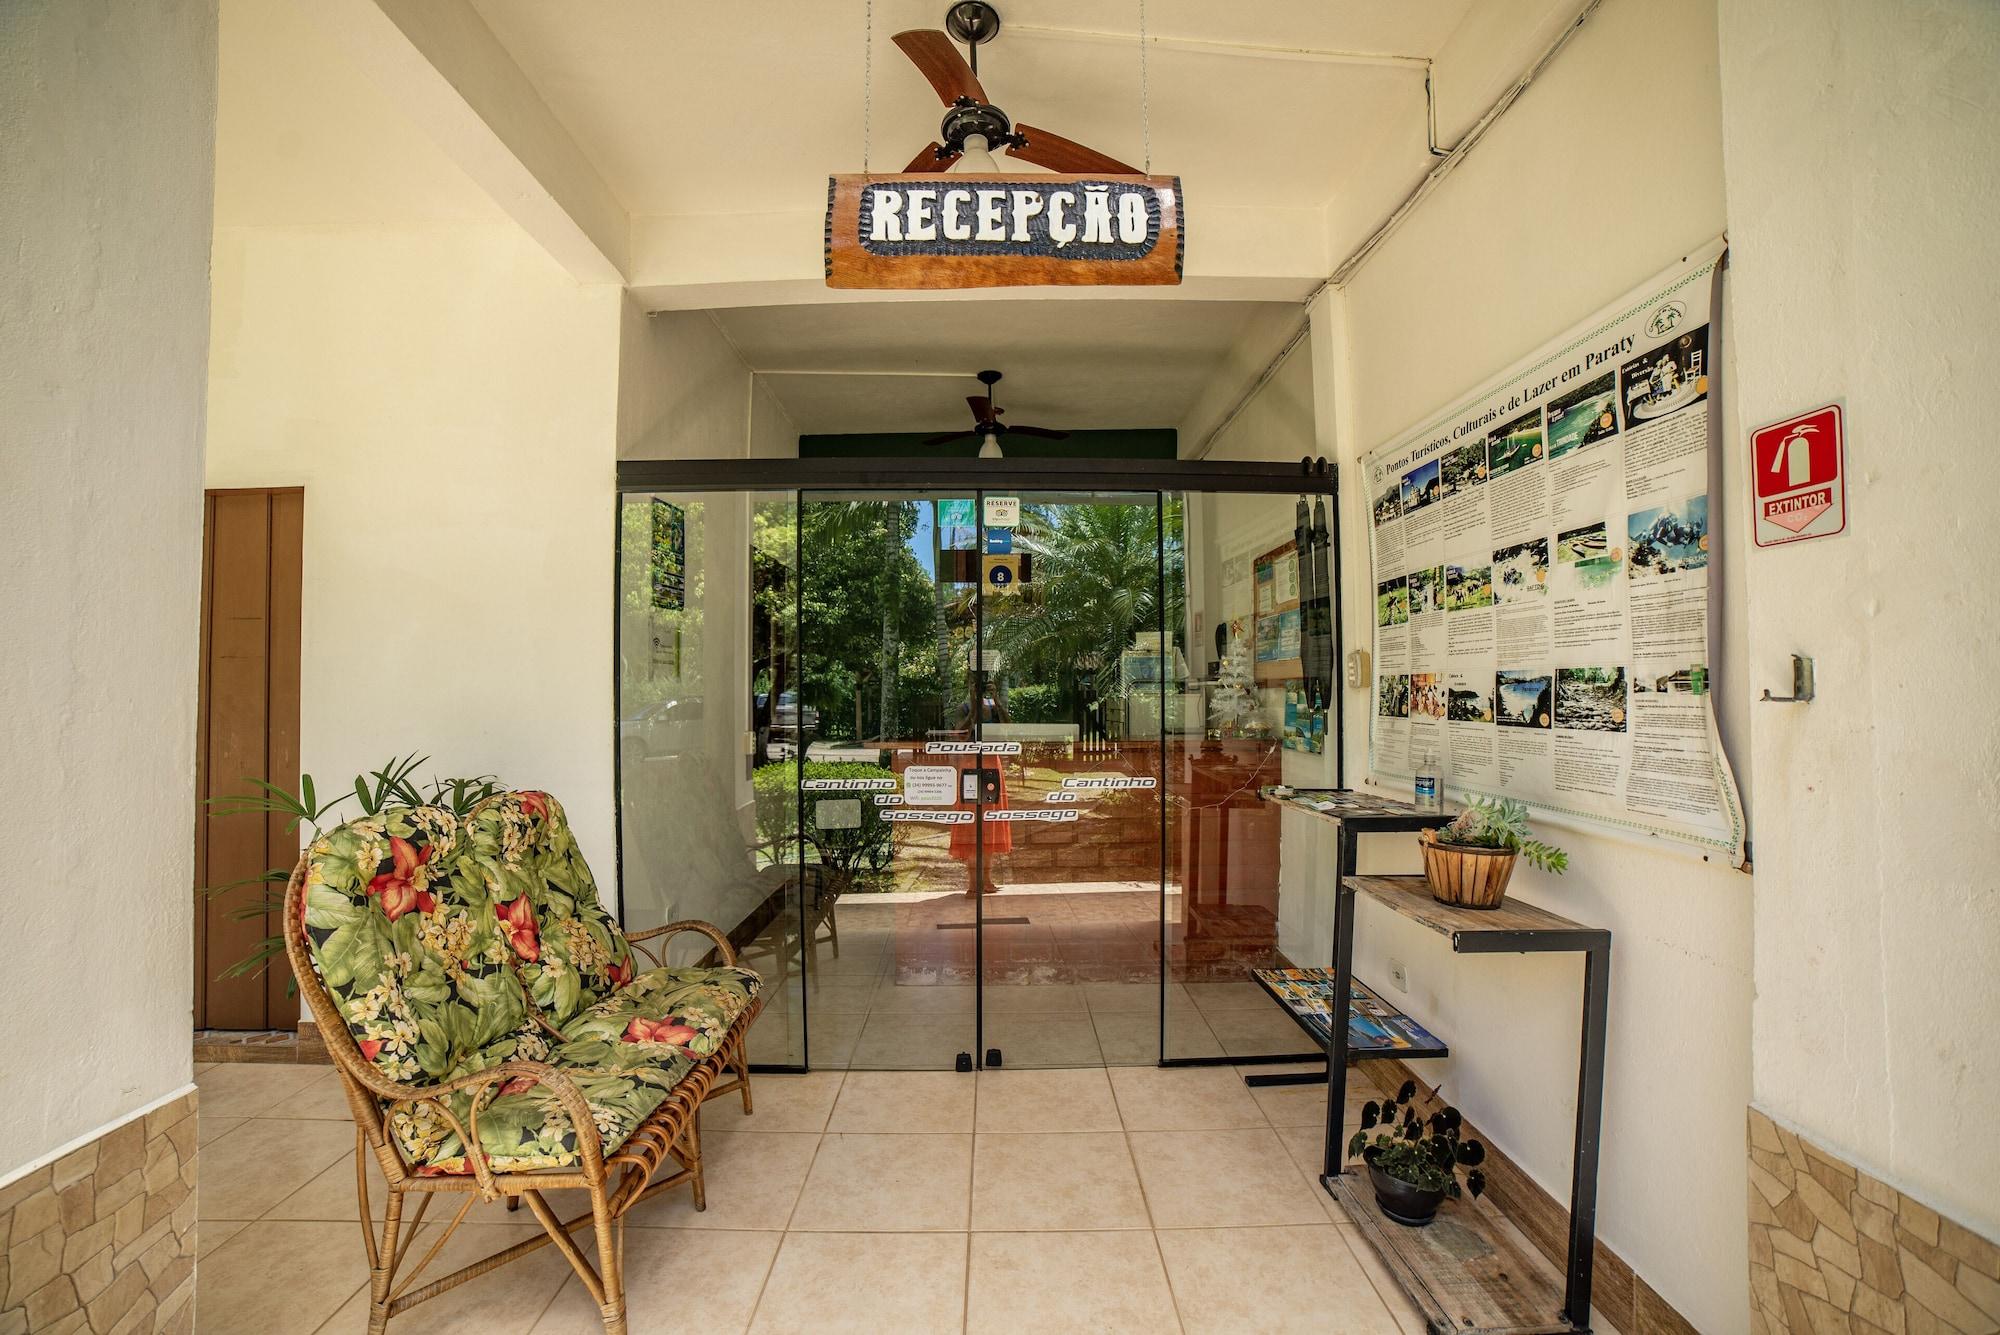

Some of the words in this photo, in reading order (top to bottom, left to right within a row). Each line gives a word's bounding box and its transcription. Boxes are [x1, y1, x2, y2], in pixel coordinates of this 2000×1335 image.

[870, 185, 1149, 249] RECEPÇÃO
[1386, 455, 1409, 475] Pontos
[1411, 435, 1451, 462] Turísticos,
[1453, 408, 1497, 440] Culturais
[1499, 405, 1505, 416] e
[1507, 396, 1520, 412] de
[1523, 376, 1558, 403] Lazer
[1561, 364, 1581, 383] em
[1585, 334, 1635, 371] Paraty
[1768, 491, 1826, 516] EXTINTOR
[997, 572, 1004, 581] 8
[926, 742, 1020, 753] Pousada
[802, 779, 895, 790] Cantinho
[1063, 777, 1155, 788] Cantinho
[875, 795, 903, 804] do
[1048, 791, 1075, 801] do
[881, 809, 974, 823] Sossego
[984, 809, 1077, 821] Sossego
